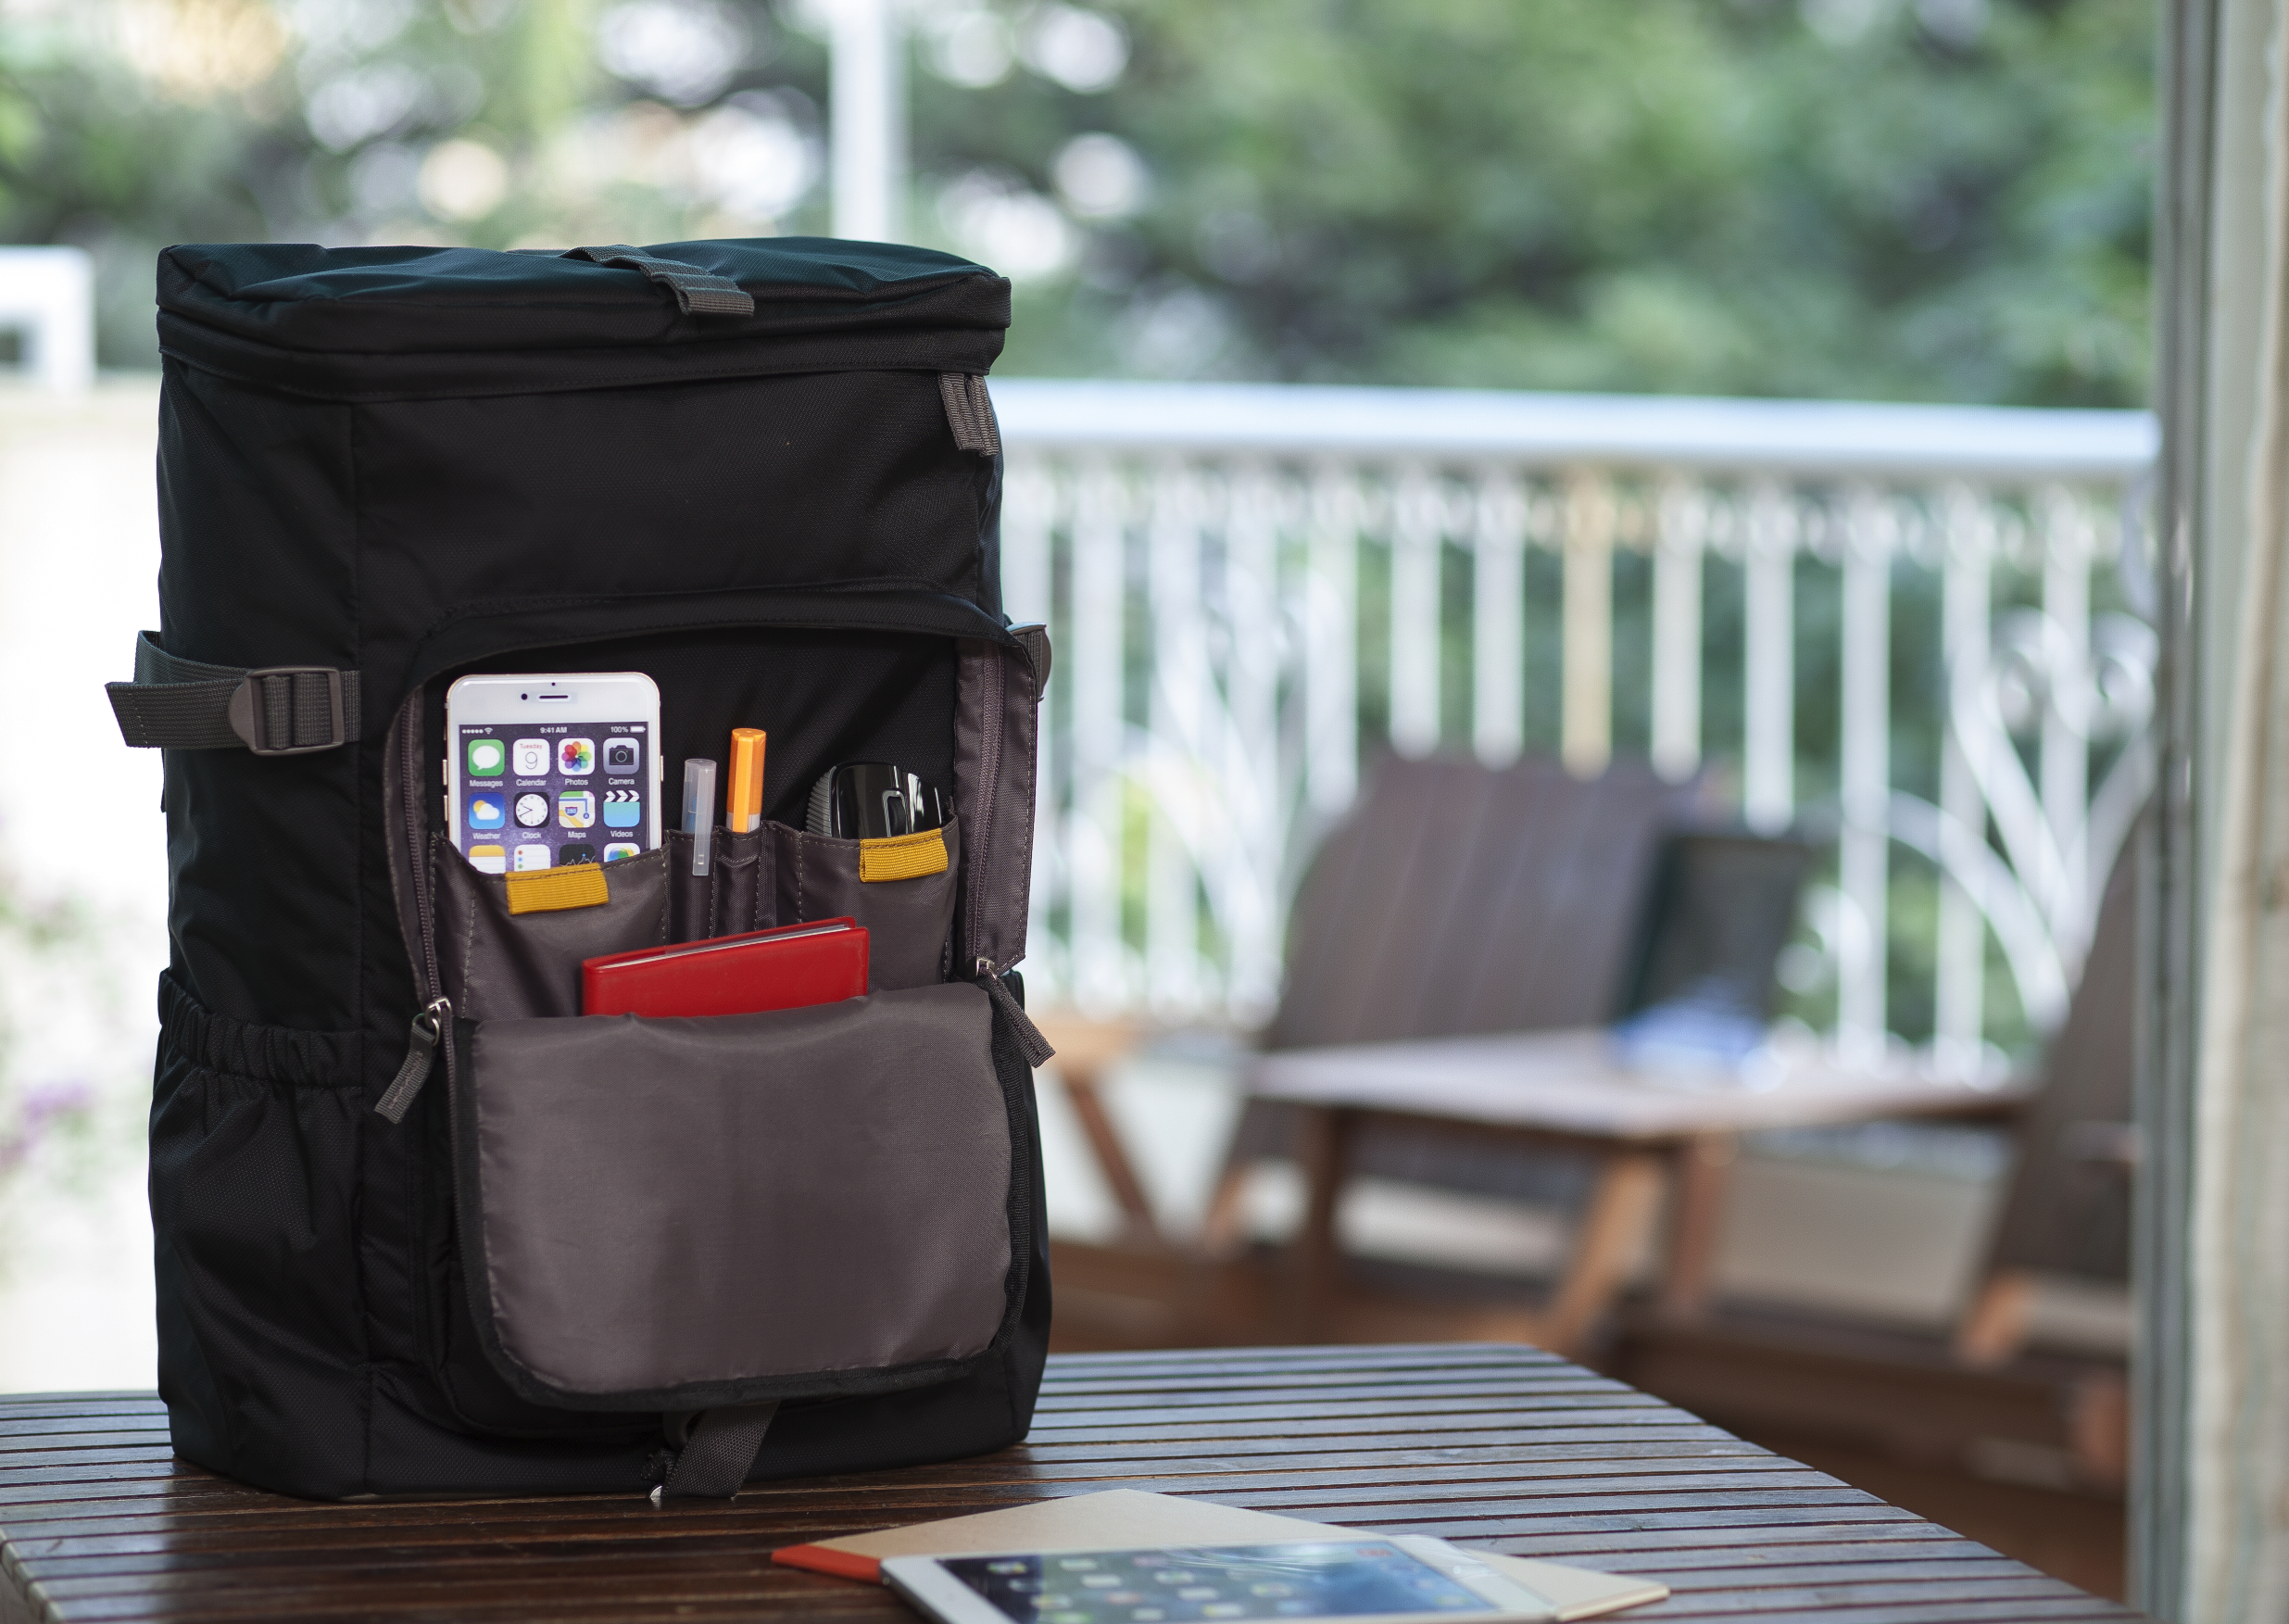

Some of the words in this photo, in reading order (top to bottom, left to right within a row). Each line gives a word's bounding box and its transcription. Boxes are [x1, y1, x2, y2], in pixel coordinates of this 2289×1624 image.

[525, 751, 537, 770] 9
[469, 779, 503, 787] Messages
[609, 777, 635, 786] Camera
[522, 831, 541, 839] Clock
[567, 831, 586, 839] Maps
